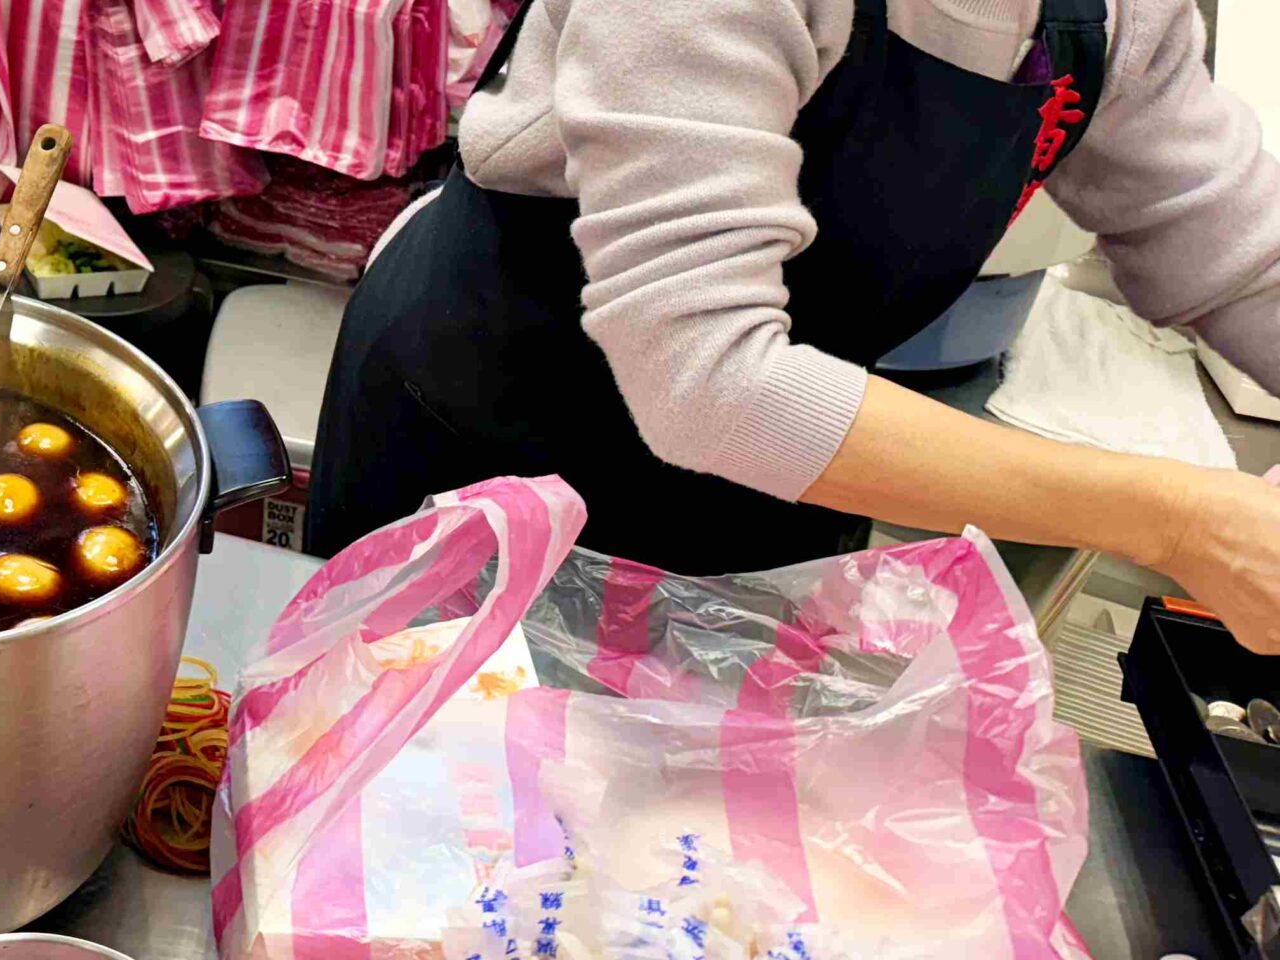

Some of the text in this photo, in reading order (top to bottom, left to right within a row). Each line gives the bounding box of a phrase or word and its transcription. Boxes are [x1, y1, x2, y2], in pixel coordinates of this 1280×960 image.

[1038, 73, 1086, 172] 香
[267, 501, 298, 514] DUST
[267, 511, 295, 524] BOX
